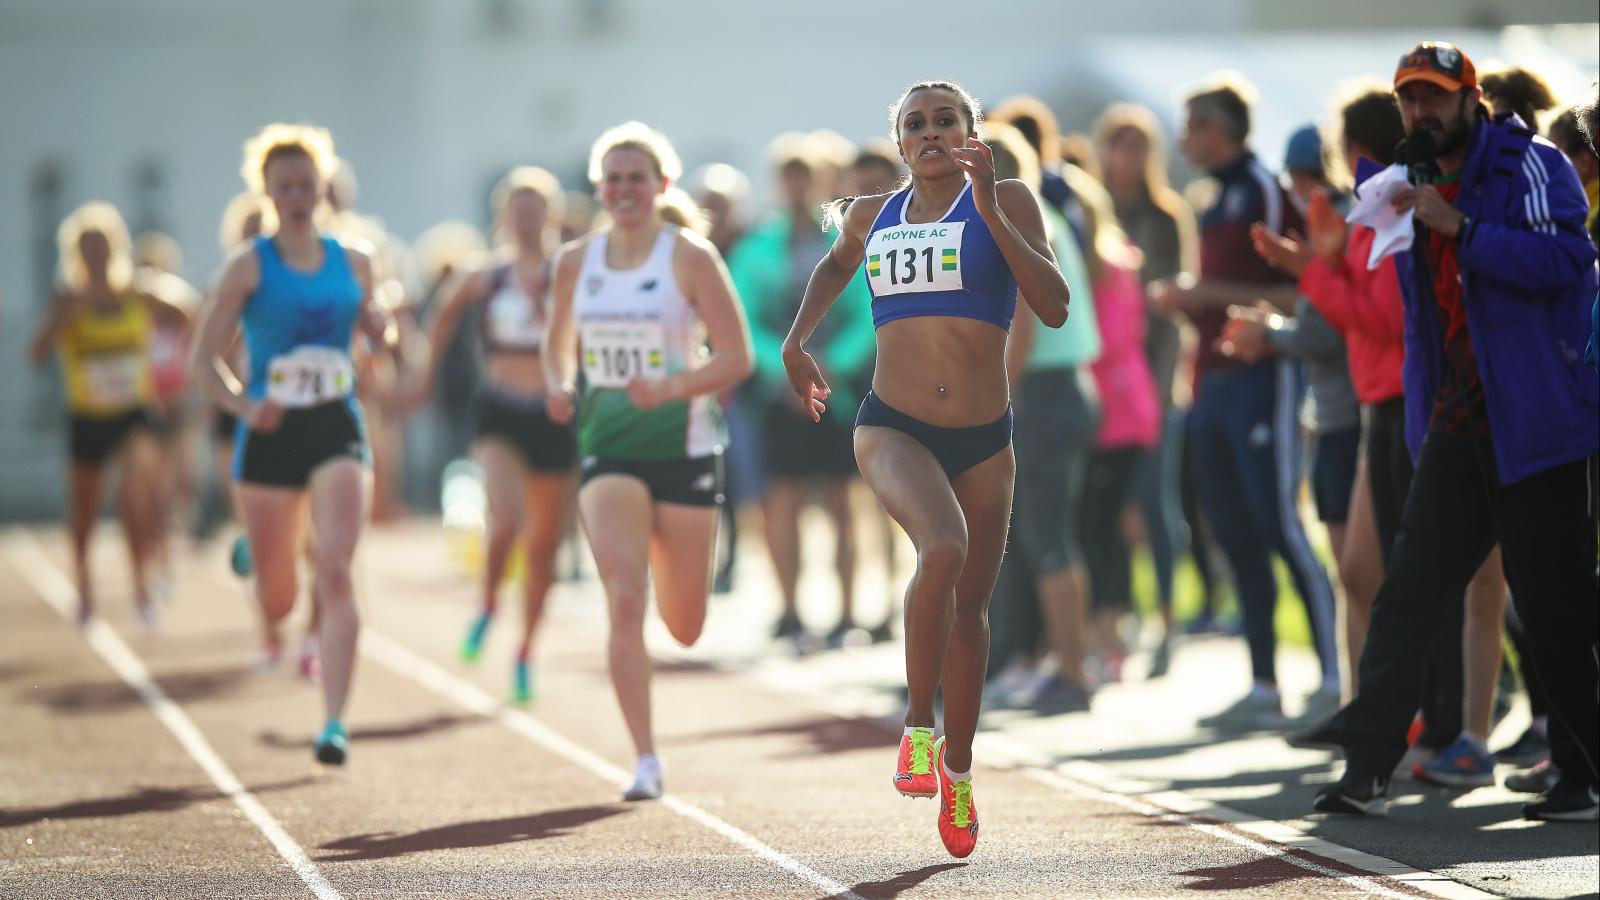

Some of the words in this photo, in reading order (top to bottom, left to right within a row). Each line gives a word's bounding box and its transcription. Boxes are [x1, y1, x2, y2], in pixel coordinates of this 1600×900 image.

[882, 229, 926, 241] MOYNE
[929, 228, 948, 237] AC
[886, 246, 934, 285] 131
[601, 346, 643, 379] 101
